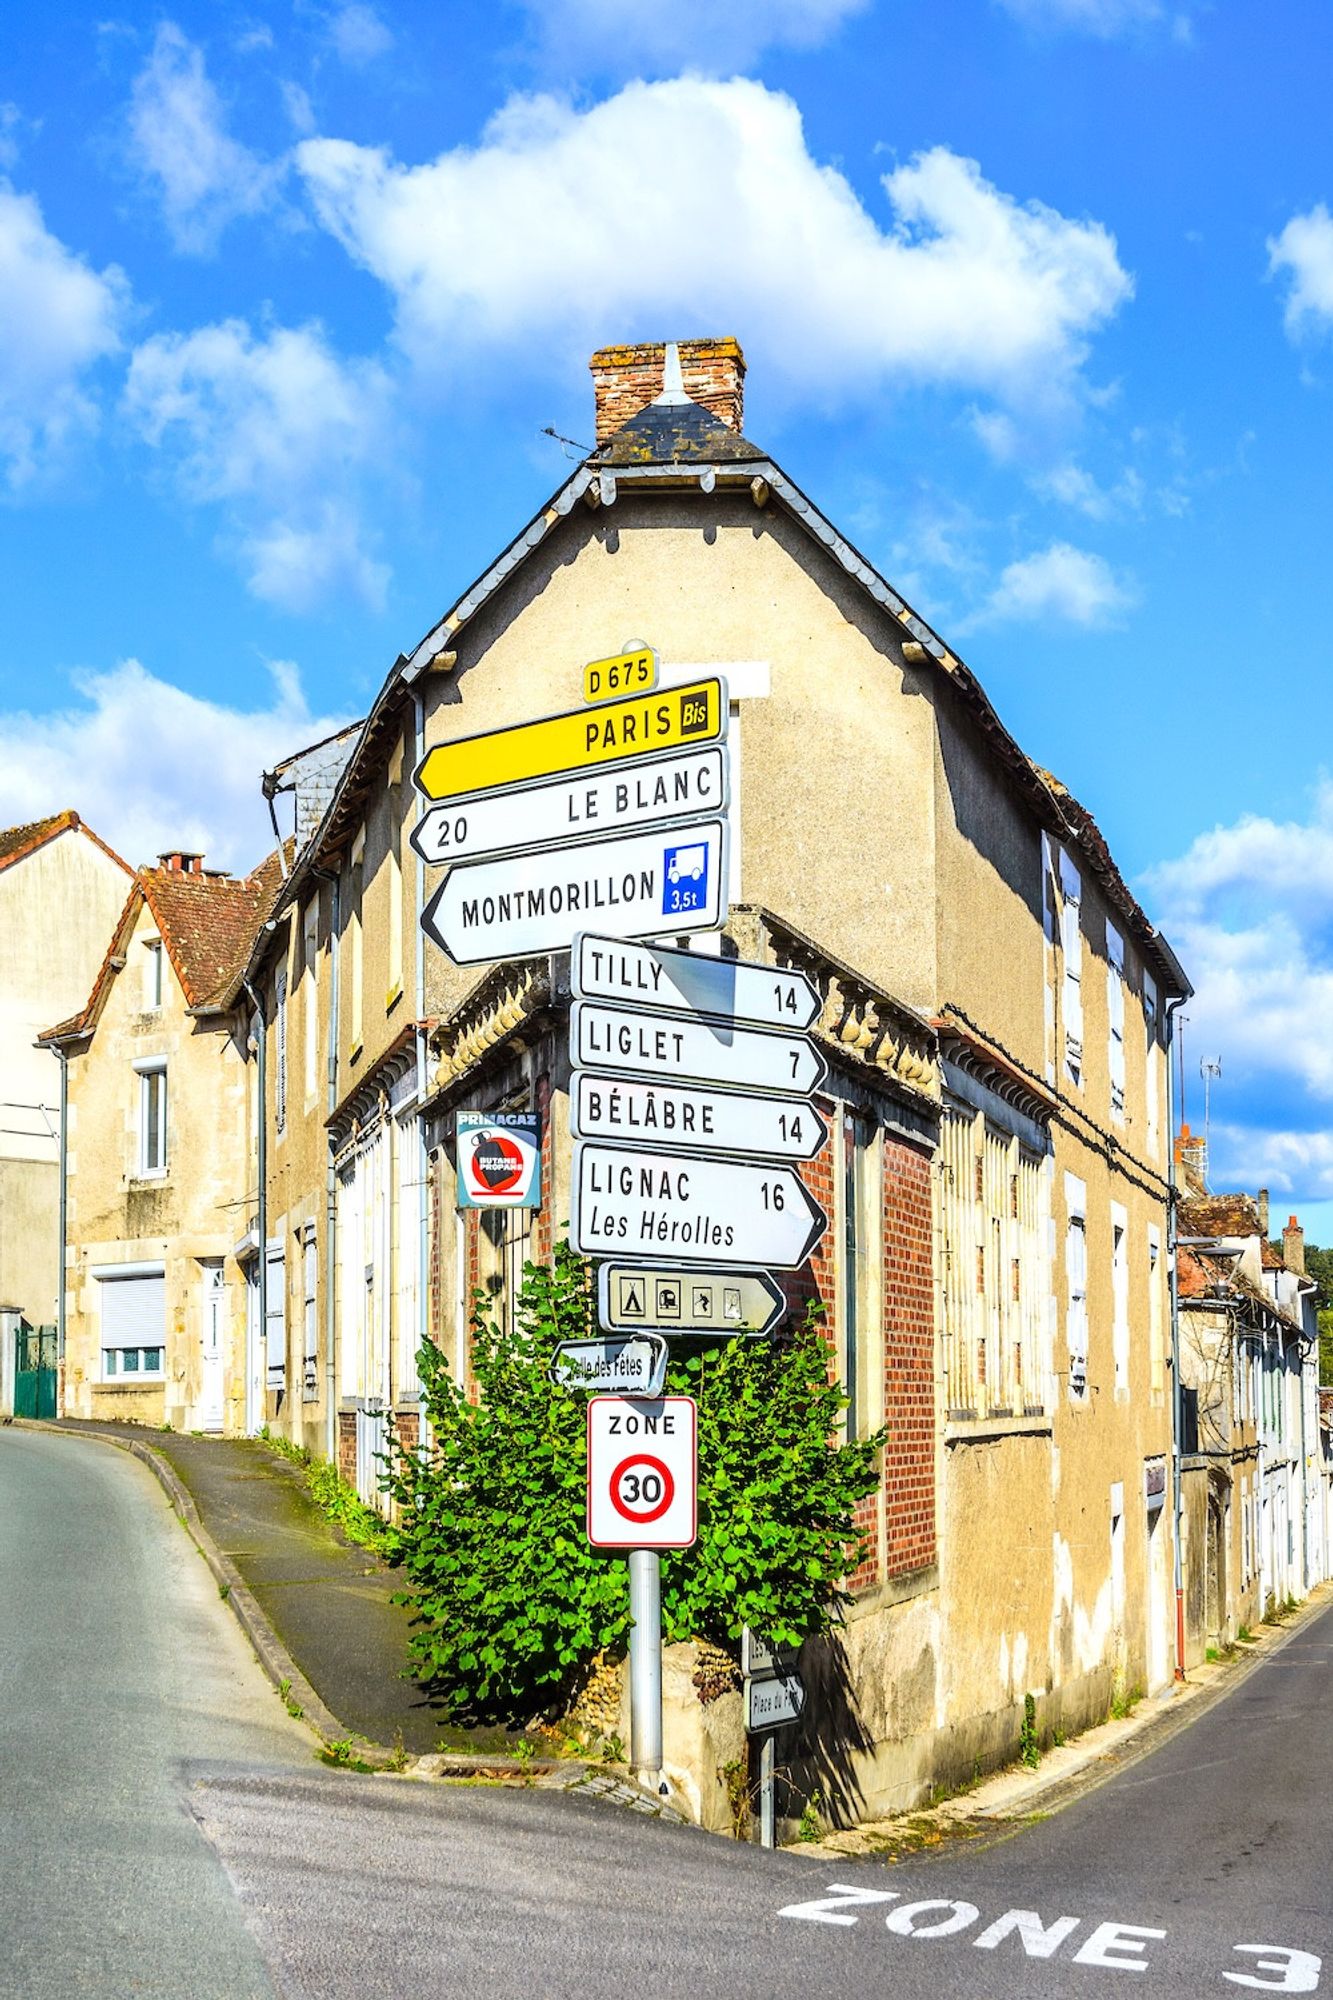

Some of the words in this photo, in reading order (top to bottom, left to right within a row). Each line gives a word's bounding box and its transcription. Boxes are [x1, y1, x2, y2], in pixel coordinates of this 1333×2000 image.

[590, 670, 600, 694] D
[609, 658, 649, 687] 675
[586, 705, 671, 752] PARIS
[682, 702, 707, 728] Bis
[568, 789, 598, 822] LE
[615, 766, 711, 813] BLANC
[437, 816, 468, 848] 20
[462, 869, 655, 928] MONTMORILLON
[671, 889, 697, 911] 3,5t
[591, 951, 663, 991] TILLY
[774, 984, 797, 1015] 14
[589, 1020, 684, 1063] LIGLET
[788, 1051, 800, 1079] 7
[458, 1114, 537, 1126] PRIMAGAZ
[588, 1087, 714, 1134] BÉLÂBRE
[778, 1114, 803, 1143] 14
[590, 1162, 689, 1201] LIGNAC
[761, 1182, 785, 1211] 16
[590, 1205, 628, 1237] Les
[639, 1210, 734, 1247] Hérolles
[594, 1355, 612, 1377] des
[609, 1415, 675, 1435] ZONE
[622, 1474, 661, 1503] 30
[776, 1884, 1167, 1971] ZONE
